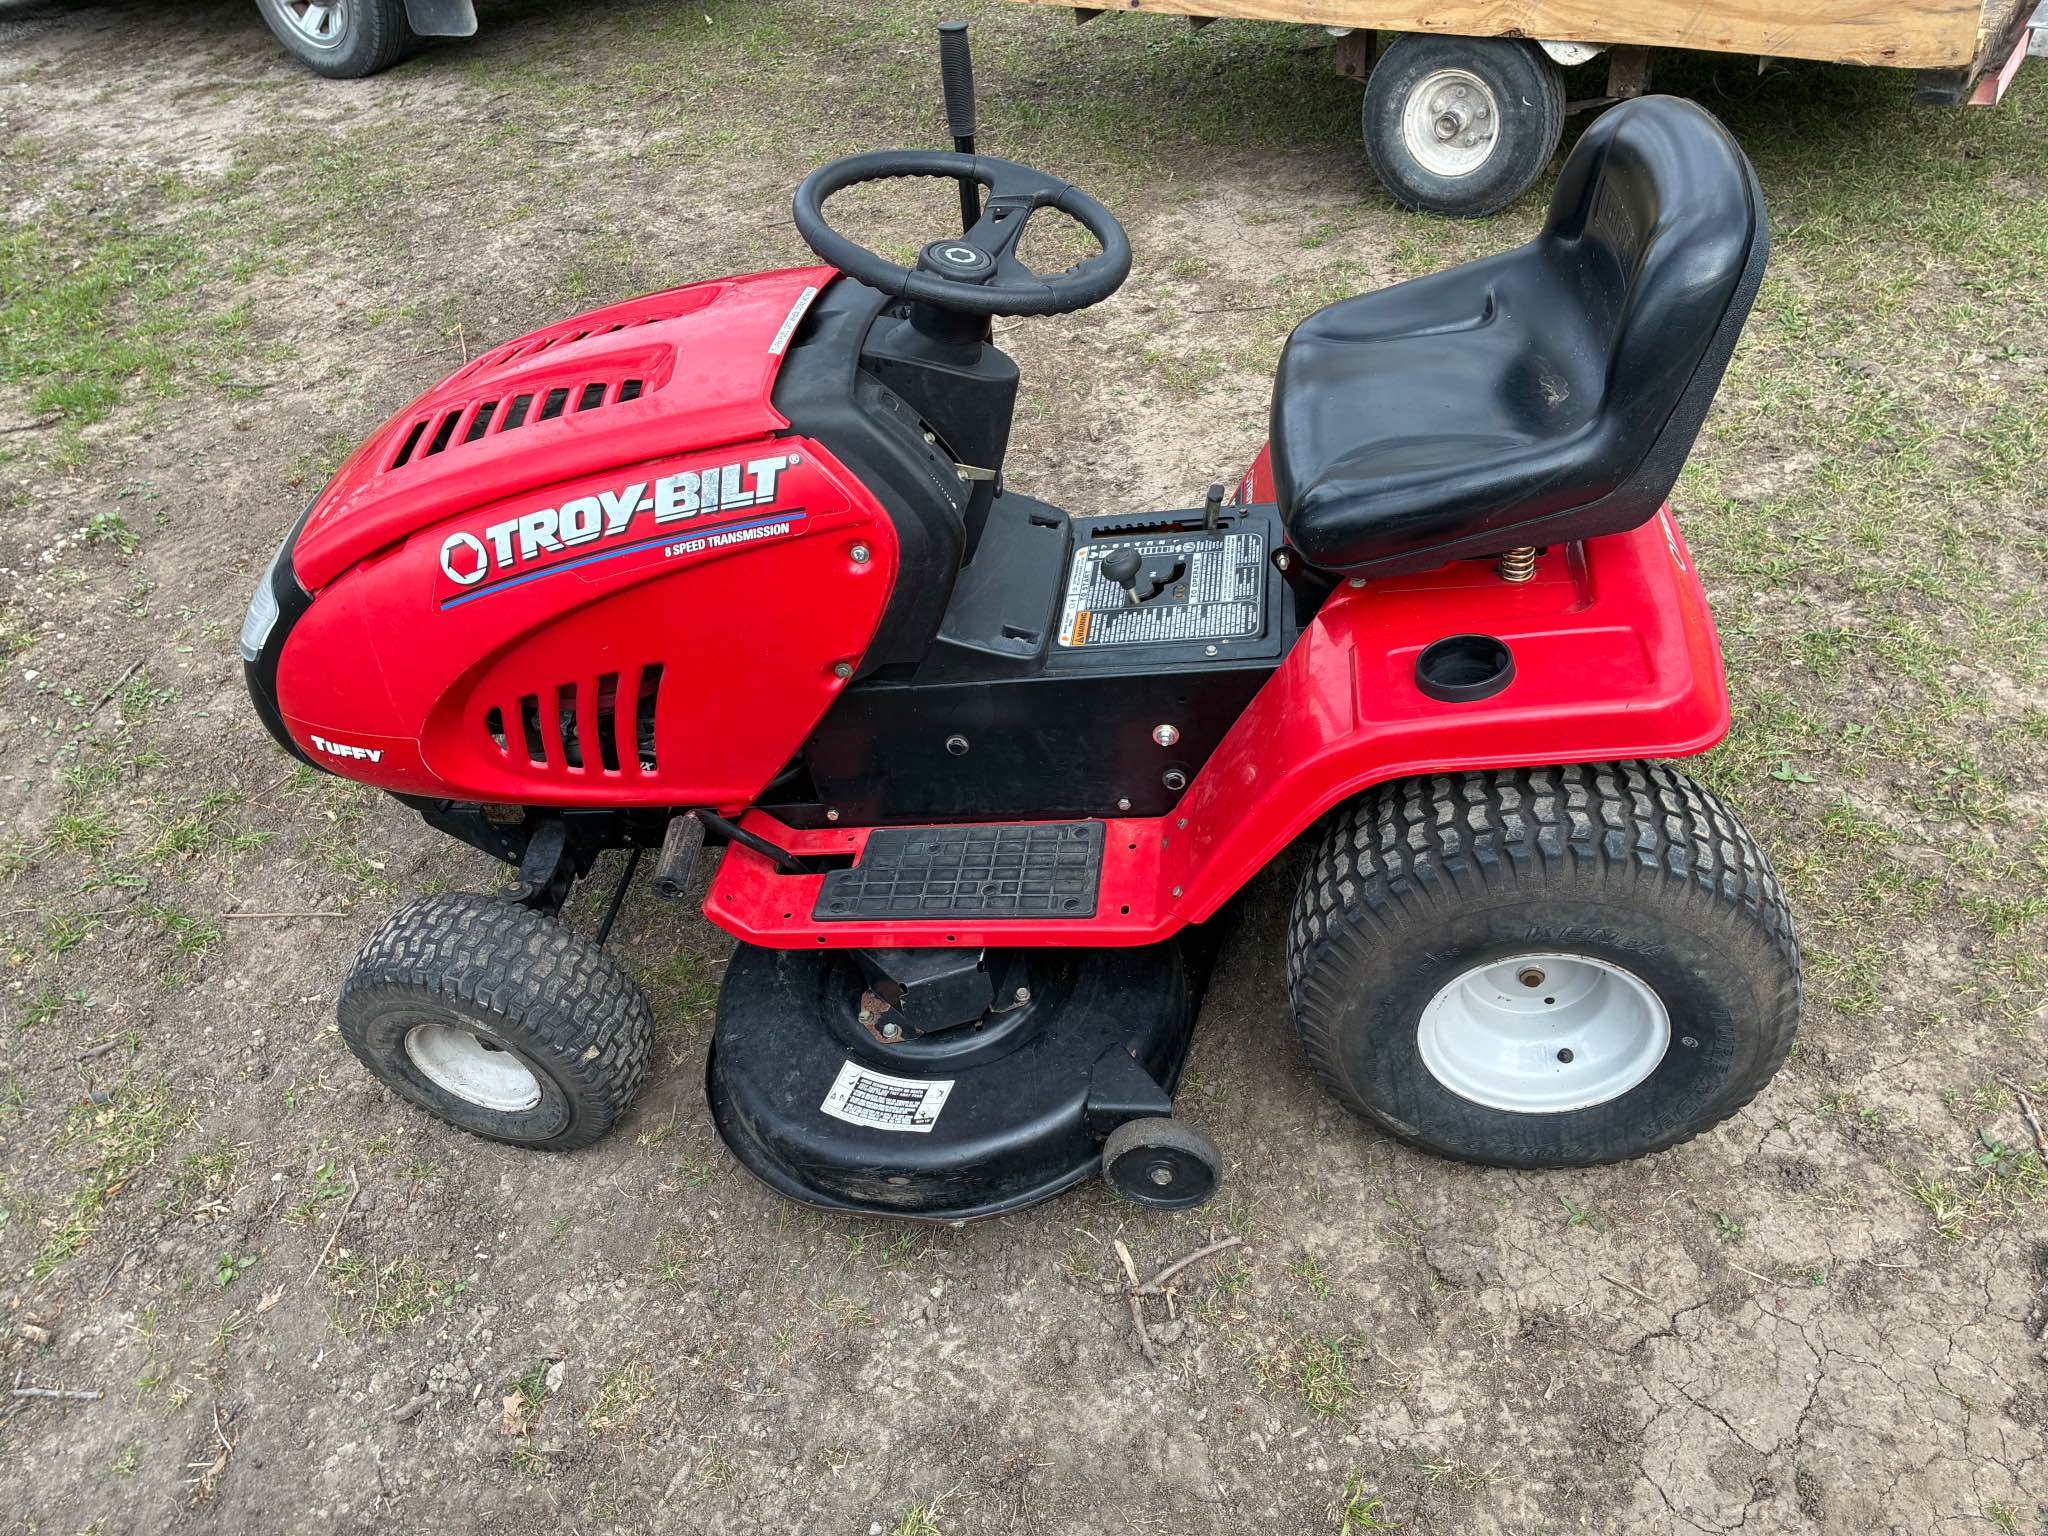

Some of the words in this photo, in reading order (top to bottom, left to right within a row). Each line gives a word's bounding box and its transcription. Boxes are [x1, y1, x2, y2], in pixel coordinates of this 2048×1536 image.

[486, 456, 787, 568] TROY-BILT
[664, 546, 672, 558] 8
[673, 538, 706, 556] SPEED
[707, 523, 790, 548] TRANSMISSION
[1081, 569, 1090, 590] START
[1192, 559, 1200, 587] OPERATE
[1076, 613, 1088, 637] WARNING
[310, 734, 382, 763] TUFFY
[1523, 926, 1666, 960] KENDA
